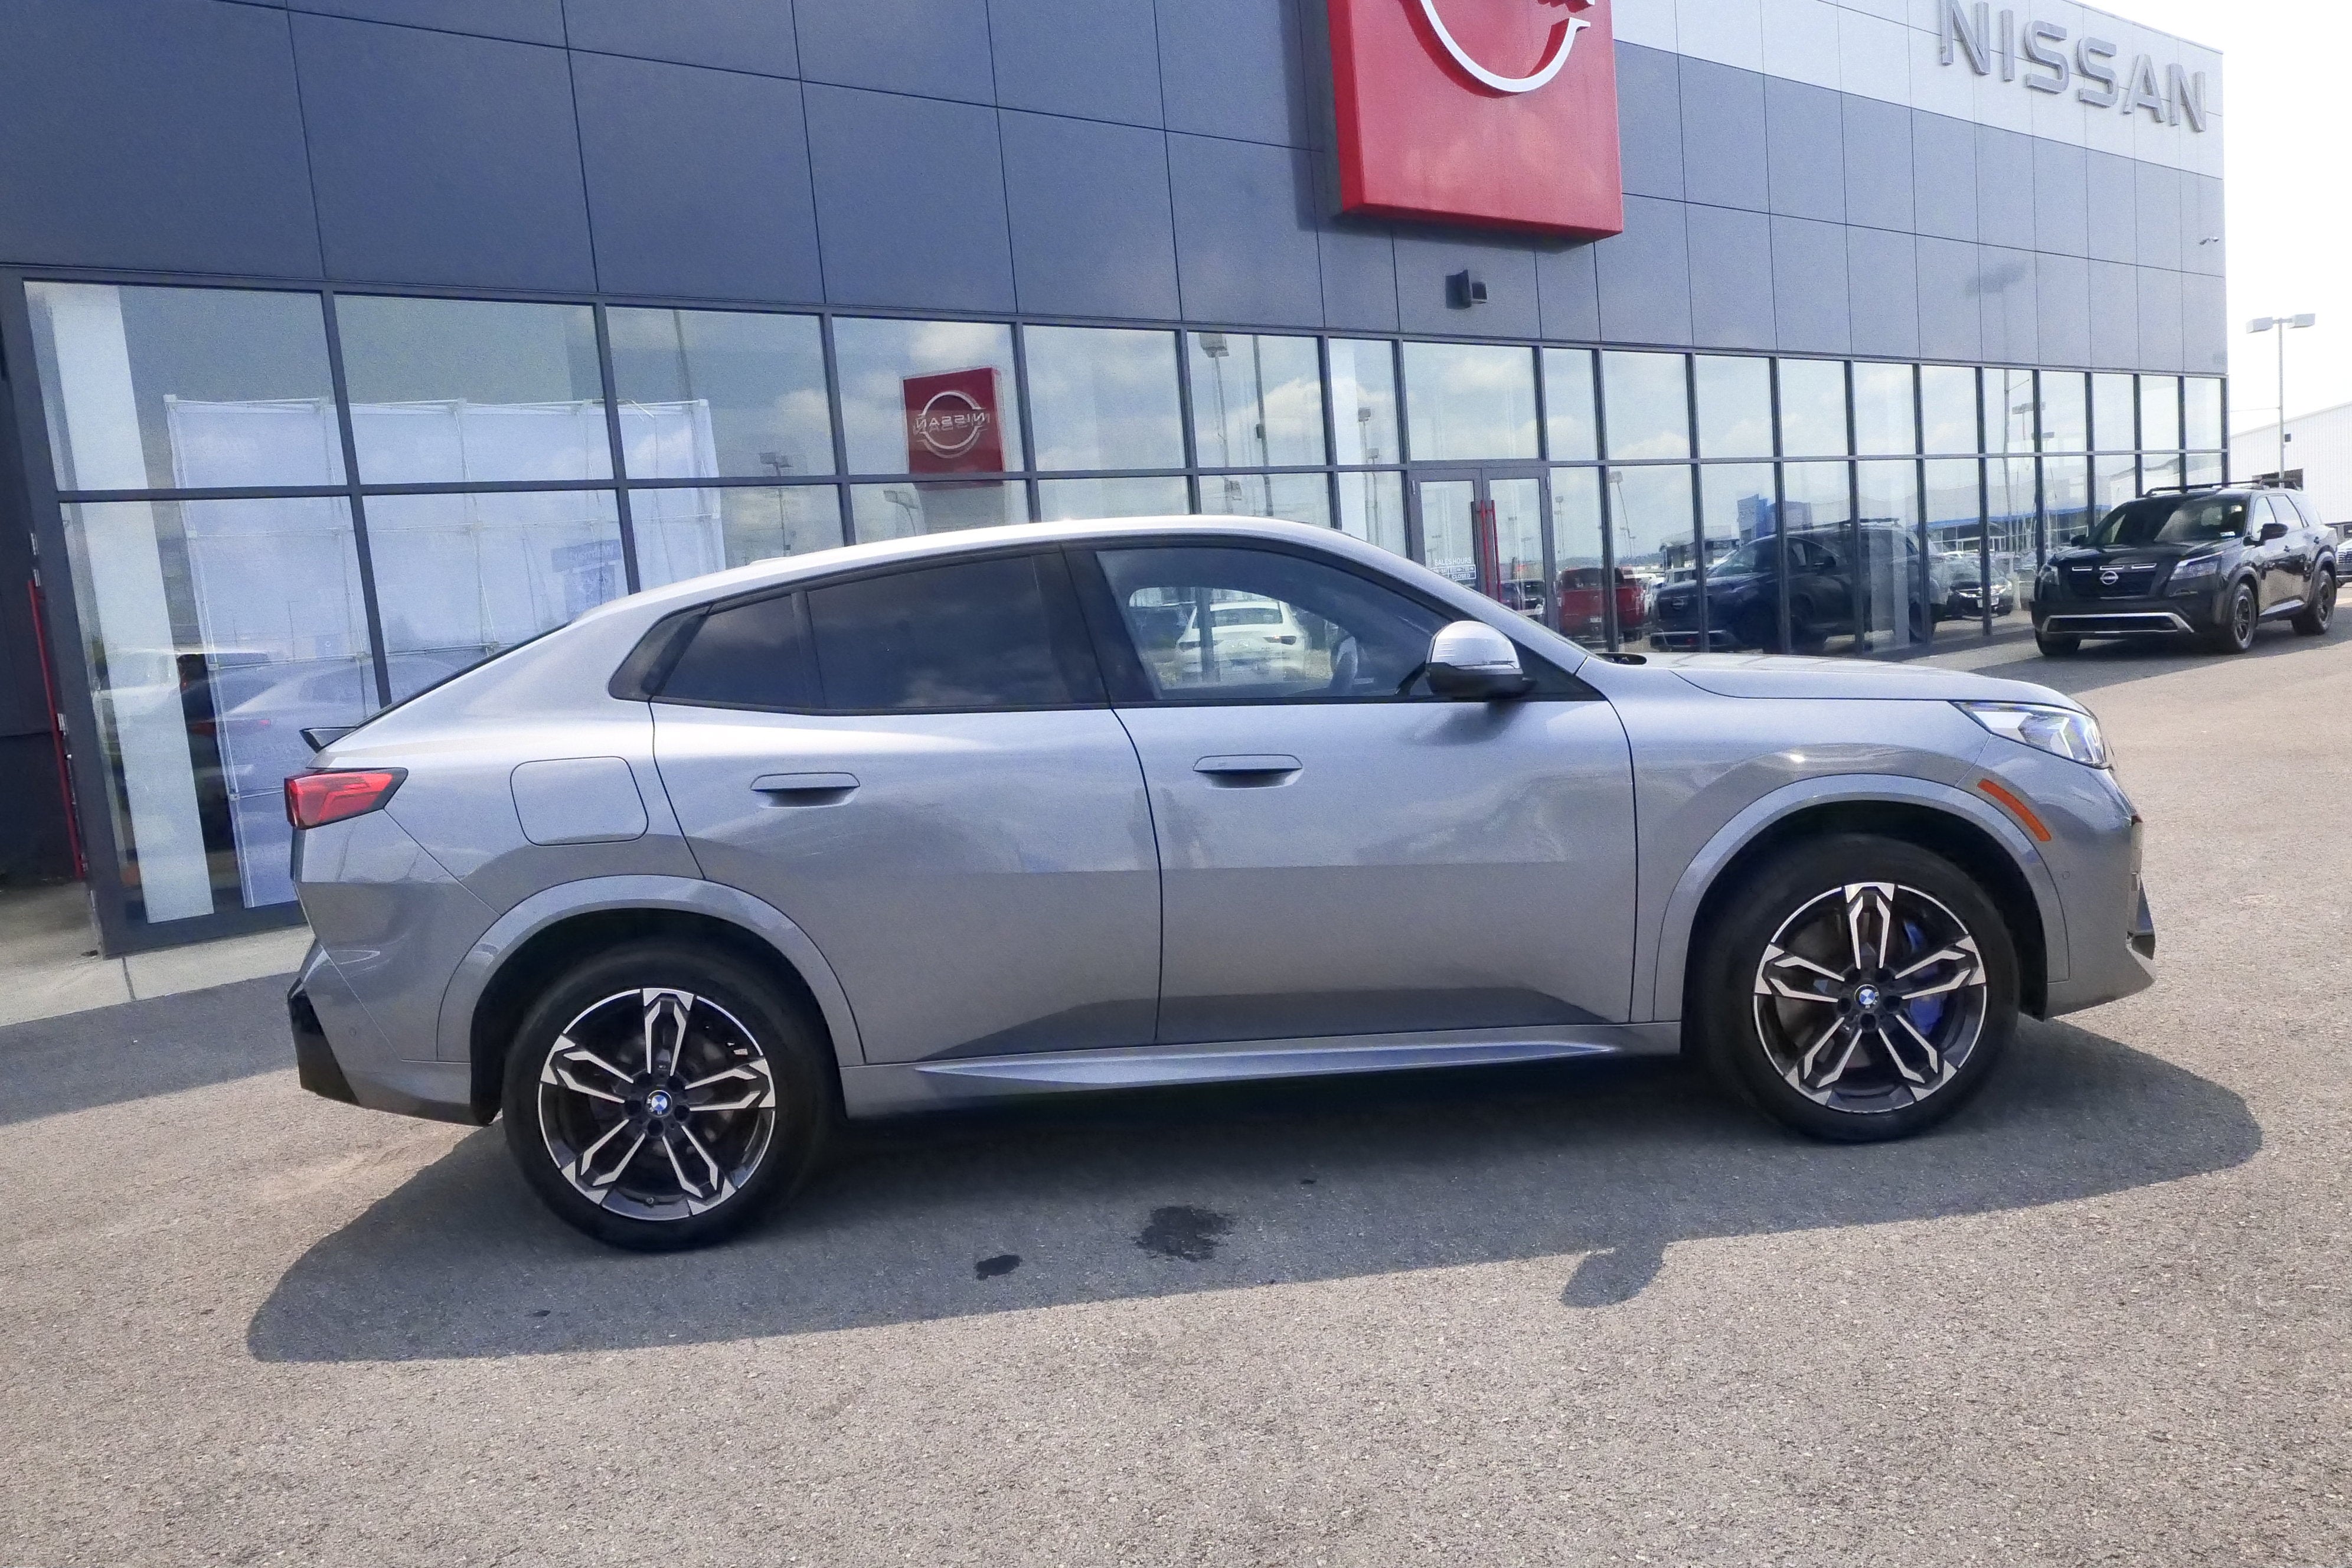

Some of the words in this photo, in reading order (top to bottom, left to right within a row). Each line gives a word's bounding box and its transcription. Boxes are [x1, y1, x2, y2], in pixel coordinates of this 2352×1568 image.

[1939, 0, 2206, 132] NISSAN
[1435, 558, 1452, 566] SALES
[1452, 557, 1472, 565] HOURS
